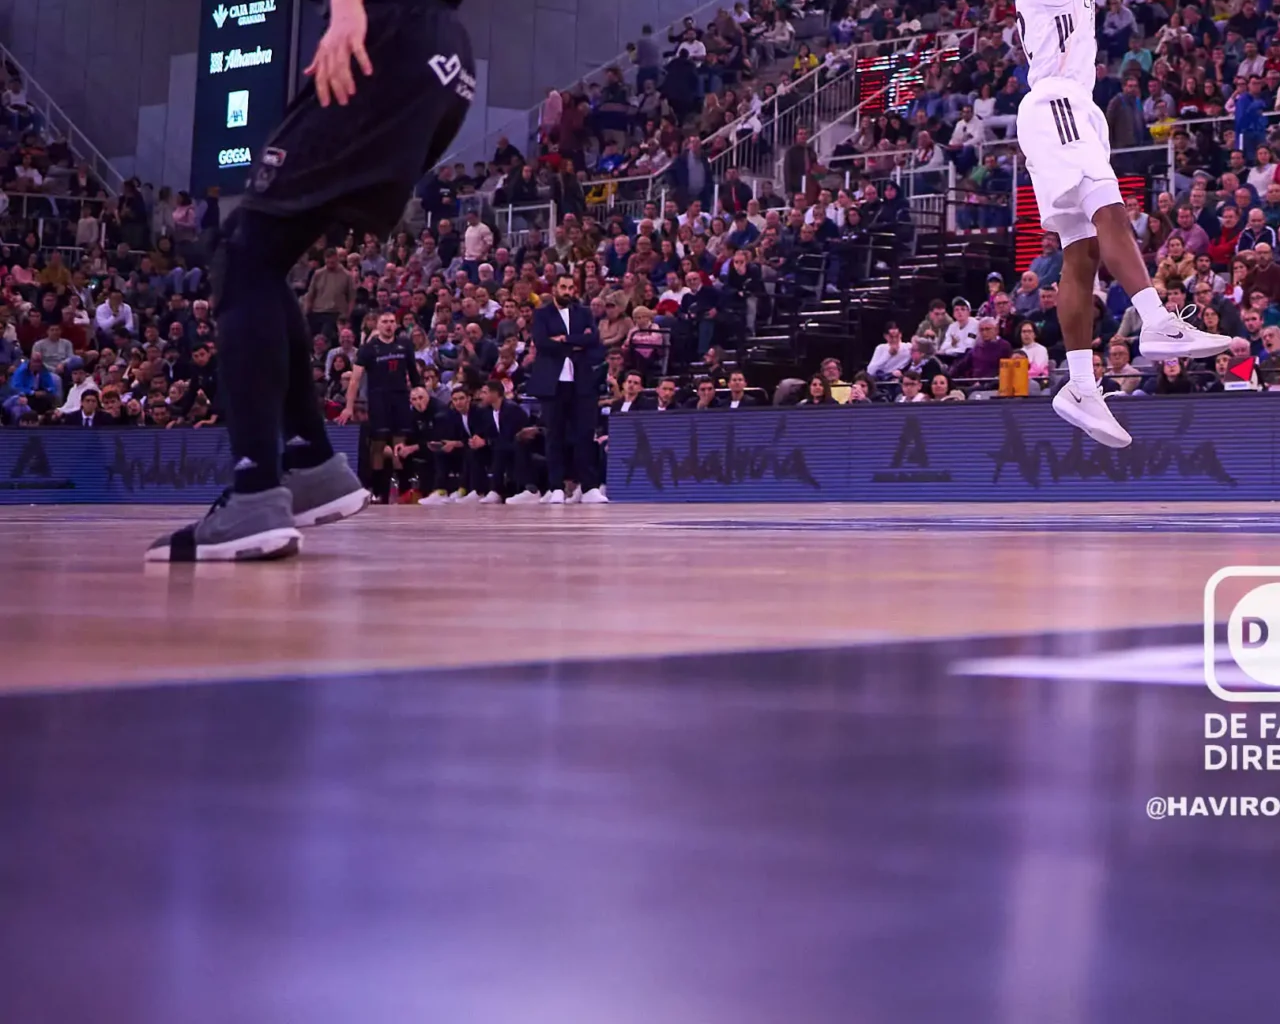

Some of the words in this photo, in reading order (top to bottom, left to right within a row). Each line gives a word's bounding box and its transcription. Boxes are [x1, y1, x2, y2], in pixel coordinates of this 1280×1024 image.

[229, 3, 248, 18] CAJA
[249, 0, 277, 15] RURAL
[224, 45, 273, 72] Alhambra
